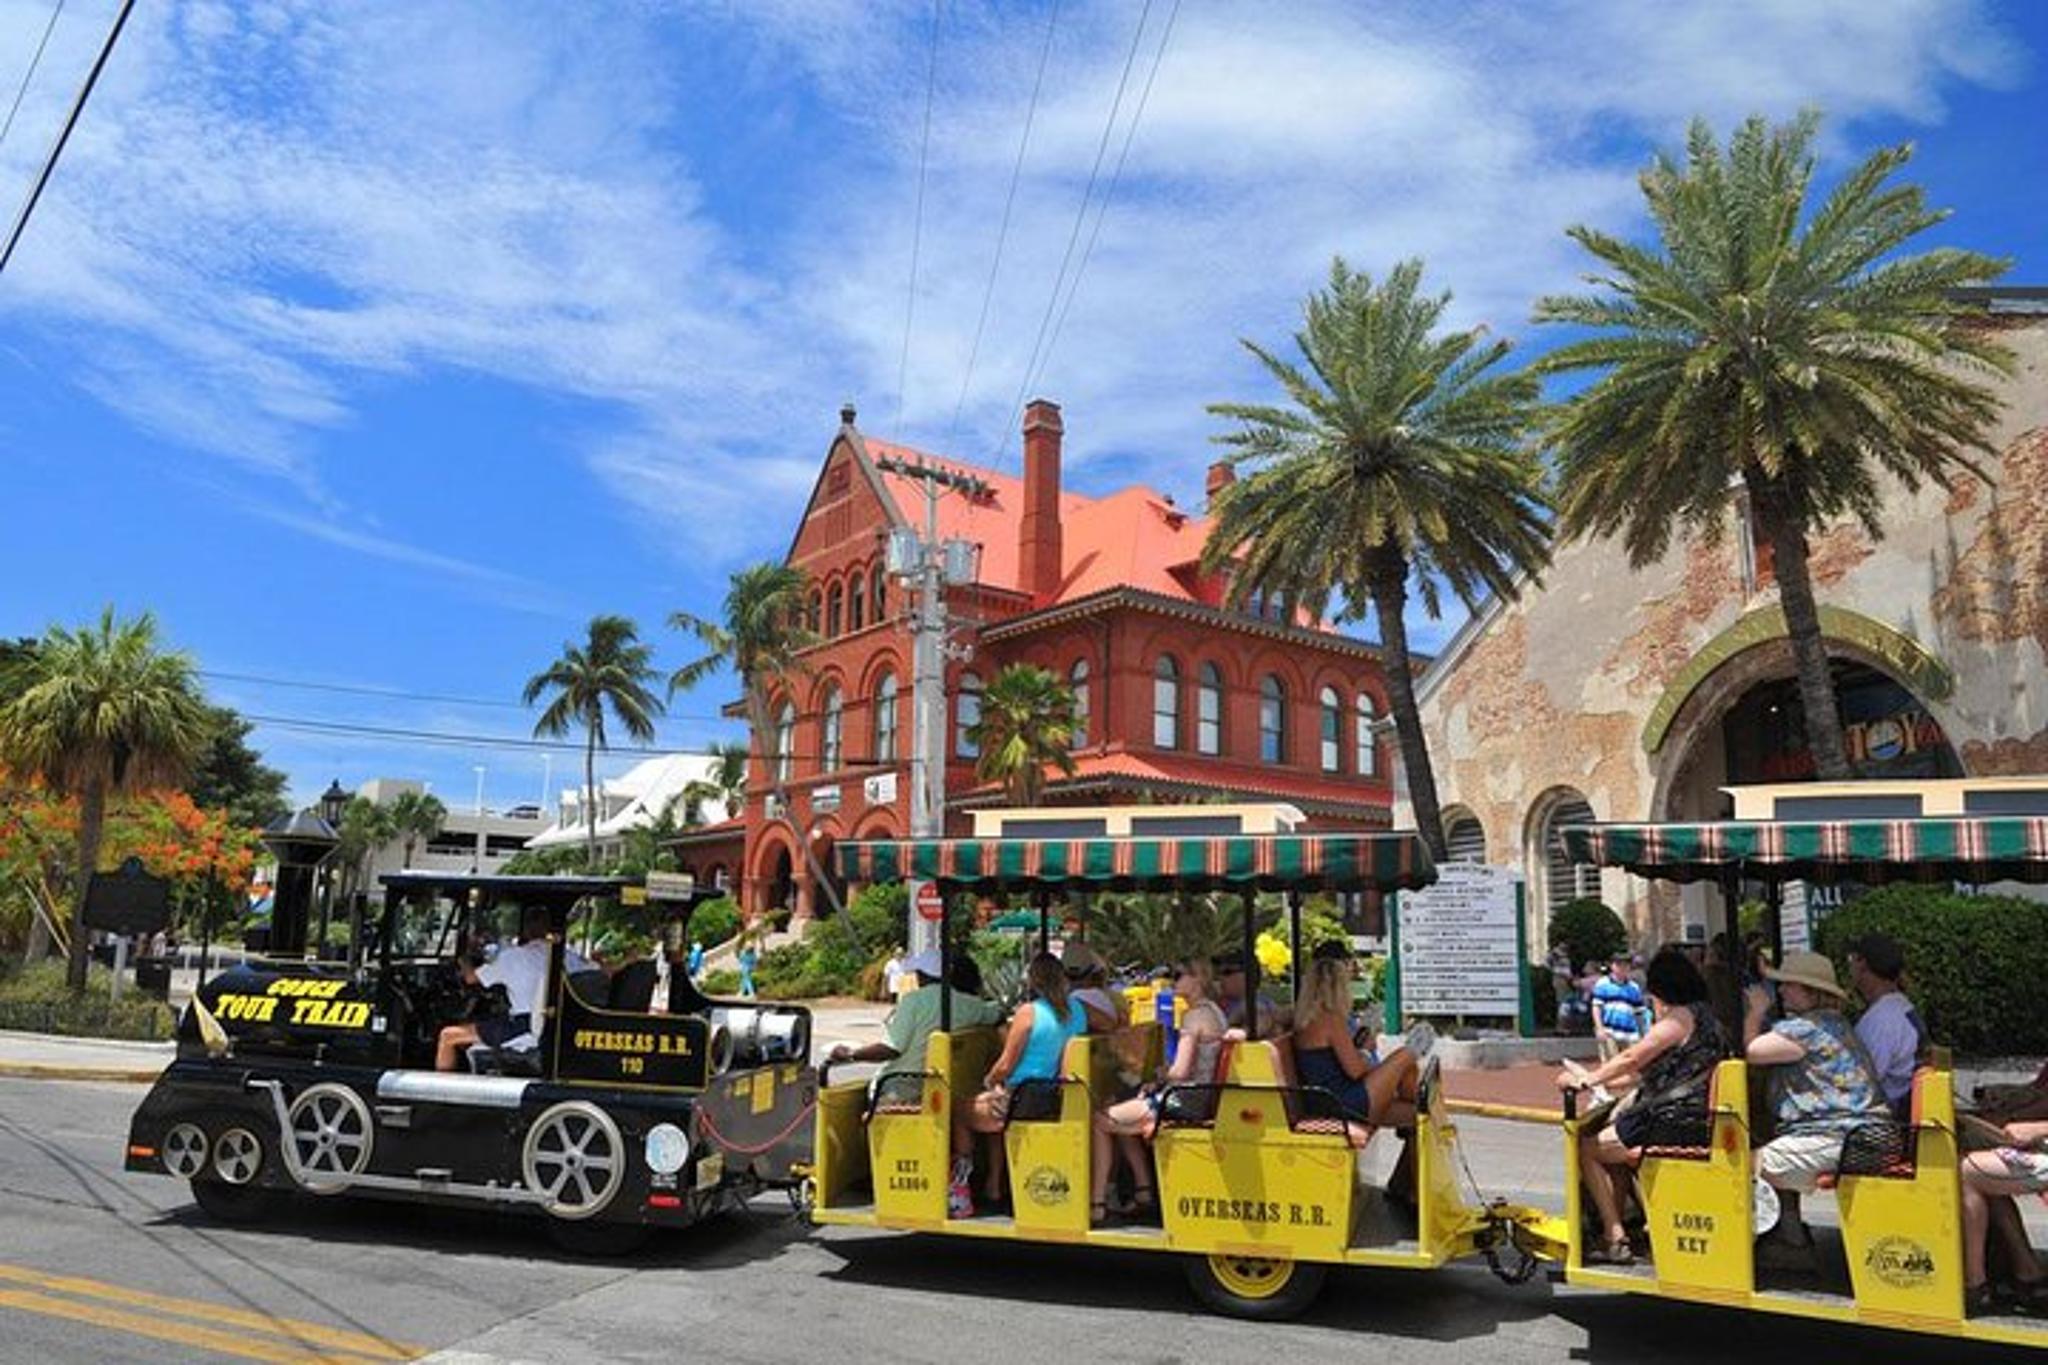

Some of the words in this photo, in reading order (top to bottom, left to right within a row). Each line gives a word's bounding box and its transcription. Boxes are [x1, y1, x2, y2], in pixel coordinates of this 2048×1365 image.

[213, 994, 279, 1022] TOUR
[290, 1000, 370, 1027] TRAIN
[574, 1030, 655, 1053] OVERSEAS
[659, 1034, 692, 1055] R.R.
[896, 1159, 920, 1173] KEY
[1178, 1197, 1281, 1223] OVERSEAS
[1289, 1203, 1333, 1226] R.R.
[1673, 1213, 1714, 1232] LONG
[1676, 1236, 1708, 1255] KEY
